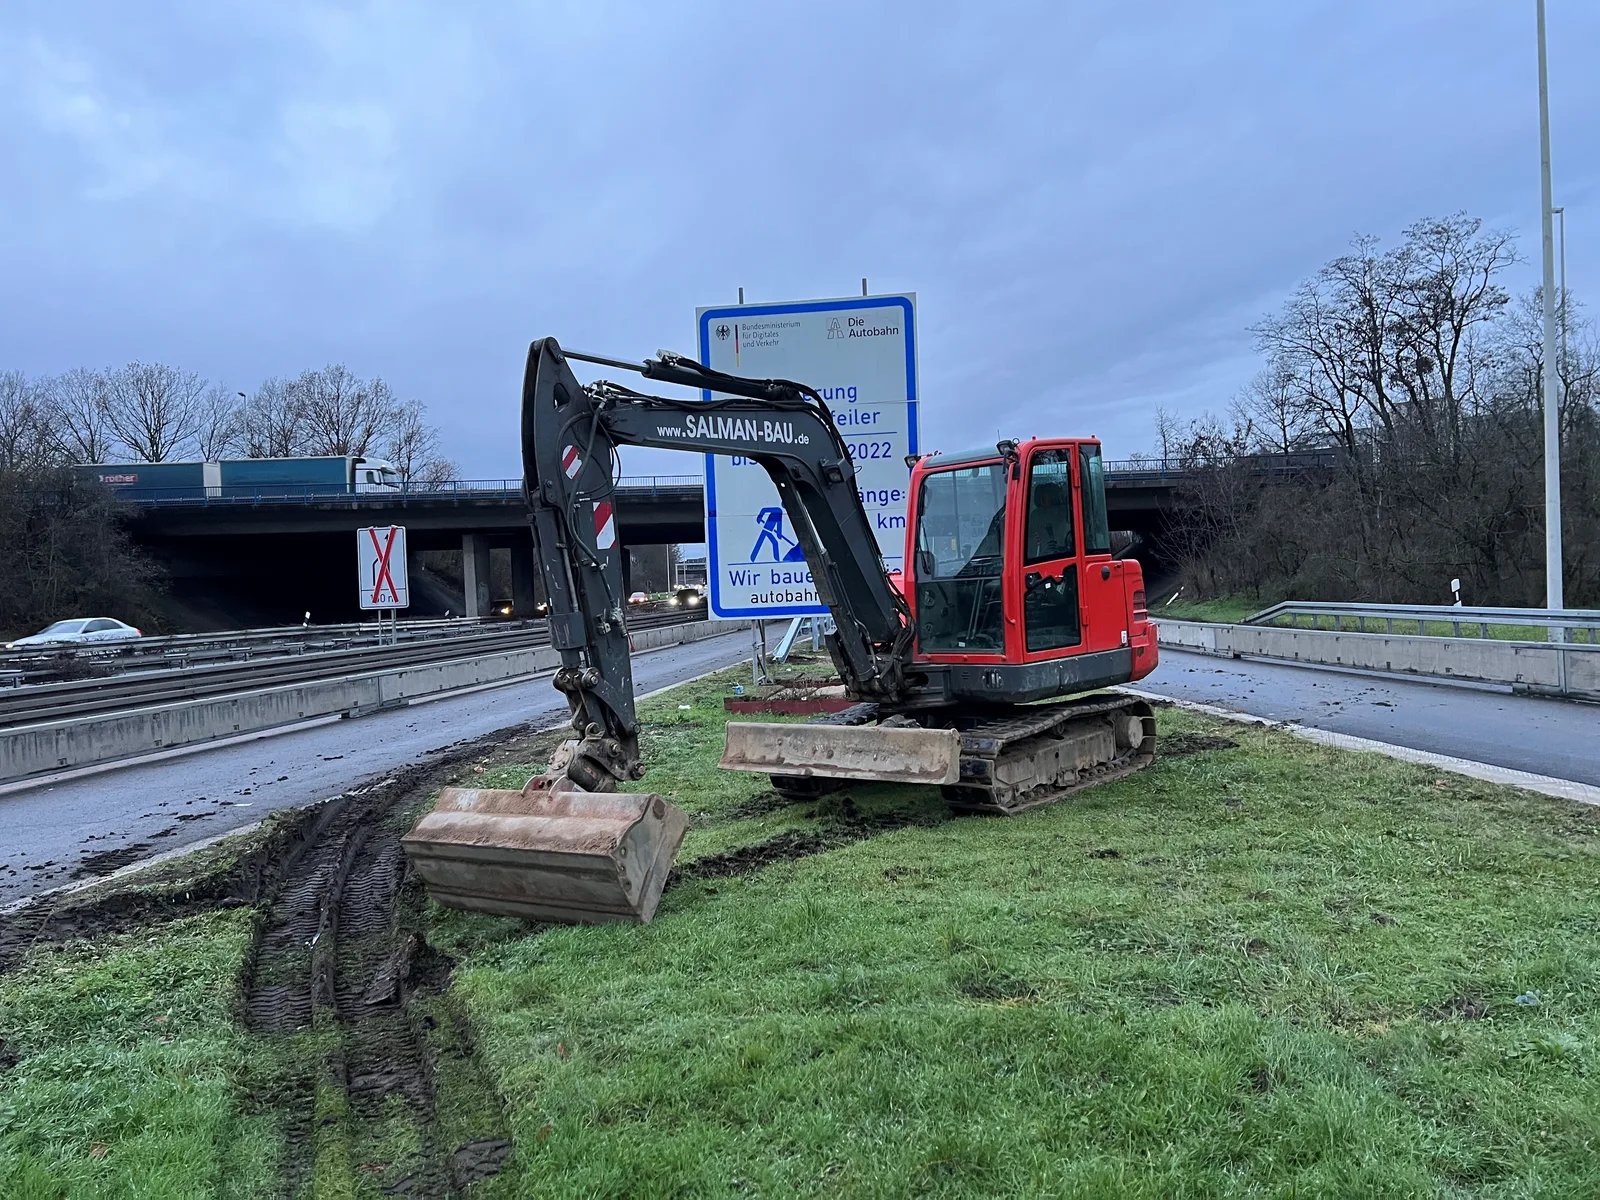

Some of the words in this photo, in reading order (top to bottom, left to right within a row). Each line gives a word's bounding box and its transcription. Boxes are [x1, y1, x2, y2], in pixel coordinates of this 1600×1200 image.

[742, 321, 801, 331] Bundesministerium
[848, 317, 864, 327] Die
[752, 331, 779, 340] Digitales
[848, 326, 899, 338] Autobahn
[742, 340, 755, 348] und
[756, 339, 780, 347] Verkehr
[656, 414, 810, 445] www.SALMAN-BAU.de
[847, 441, 892, 460] 2022
[877, 513, 906, 529] km
[729, 569, 761, 586] Wir
